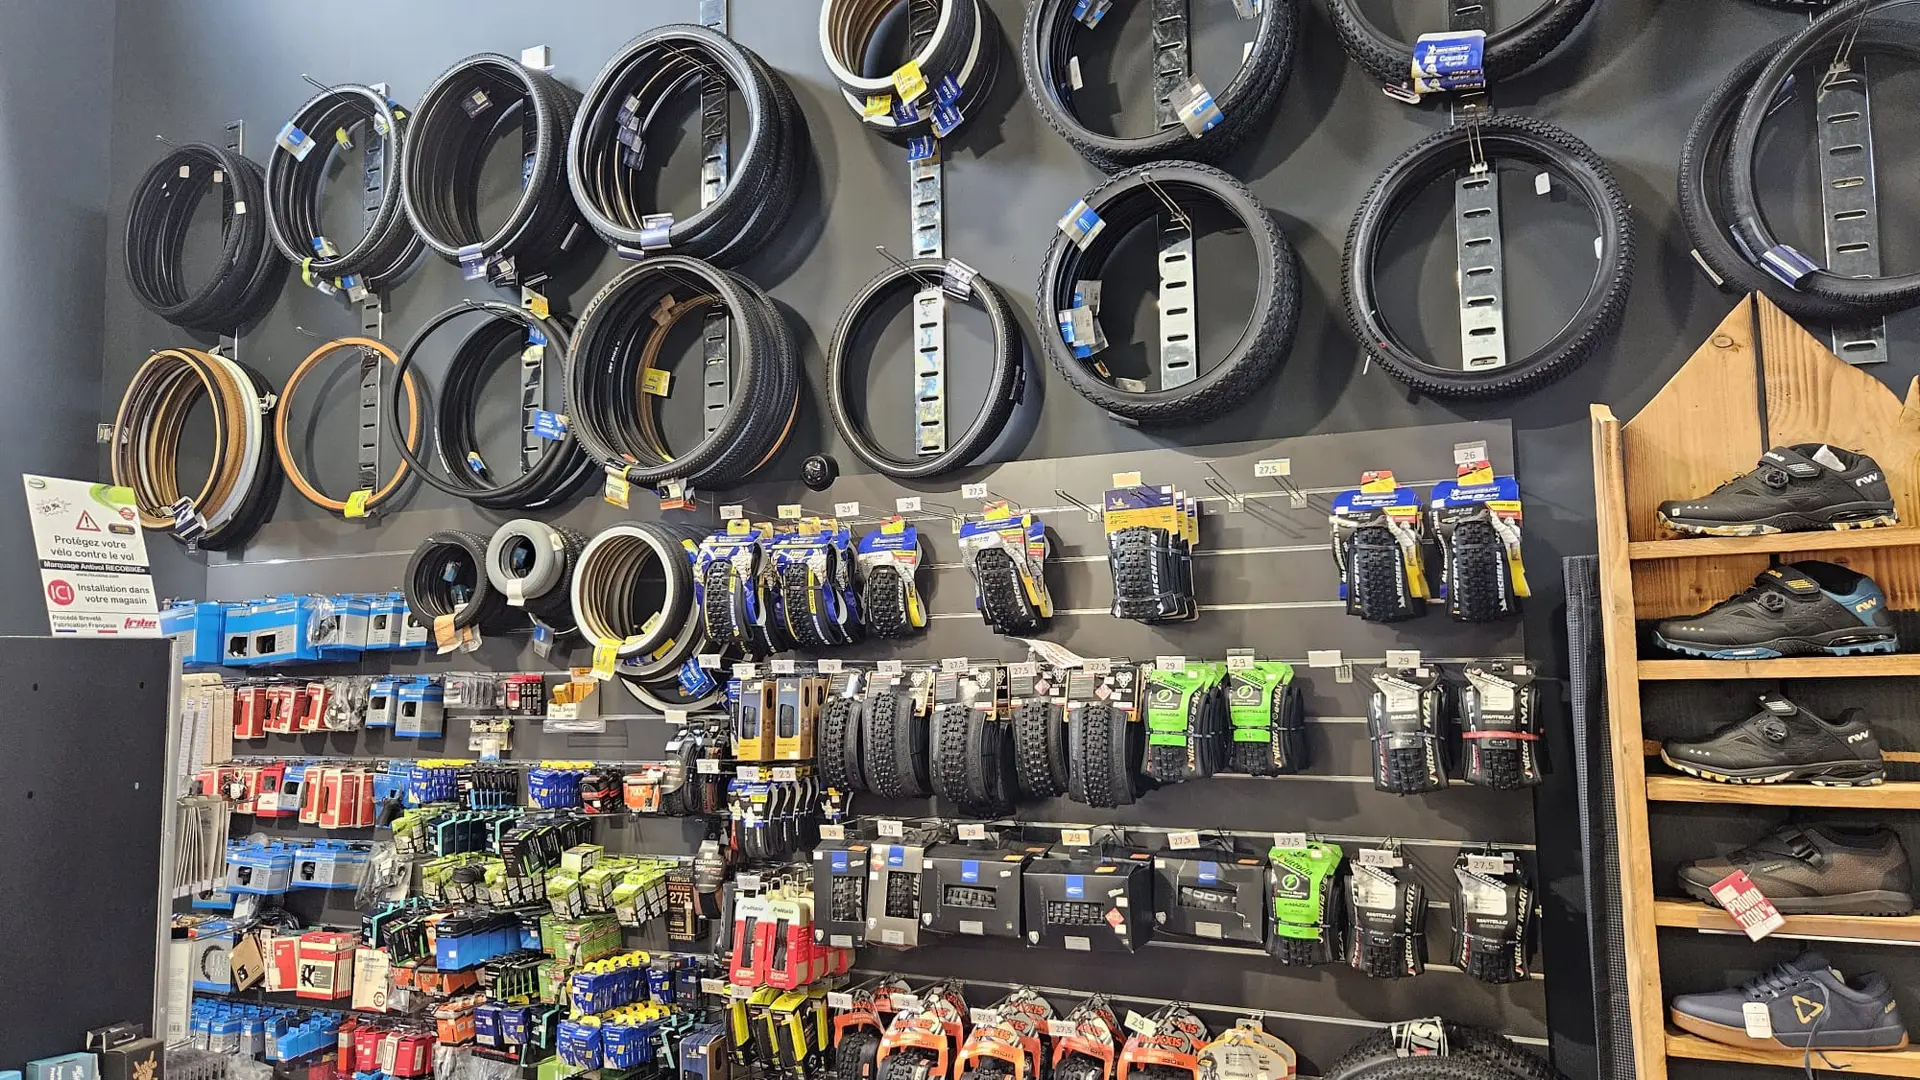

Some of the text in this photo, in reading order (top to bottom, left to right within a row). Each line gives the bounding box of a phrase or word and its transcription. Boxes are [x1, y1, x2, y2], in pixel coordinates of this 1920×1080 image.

[1463, 451, 1476, 460] 26
[905, 501, 914, 509] 29
[54, 535, 127, 549] Protégez votre
[50, 548, 135, 561] vélo contre le vol
[1150, 533, 1160, 600] MICHELIN
[50, 584, 72, 601] ICI
[77, 583, 150, 594] Installation dans
[85, 595, 148, 606] votre magasin
[1165, 662, 1176, 670] 29
[1231, 658, 1246, 668] 29
[1398, 657, 1410, 666] 29
[884, 664, 893, 673] 29
[966, 828, 976, 836] 29
[1068, 833, 1081, 843] 29
[669, 891, 691, 904] 27.5
[1727, 887, 1764, 917] PROMO
[1131, 1017, 1145, 1030] 29
